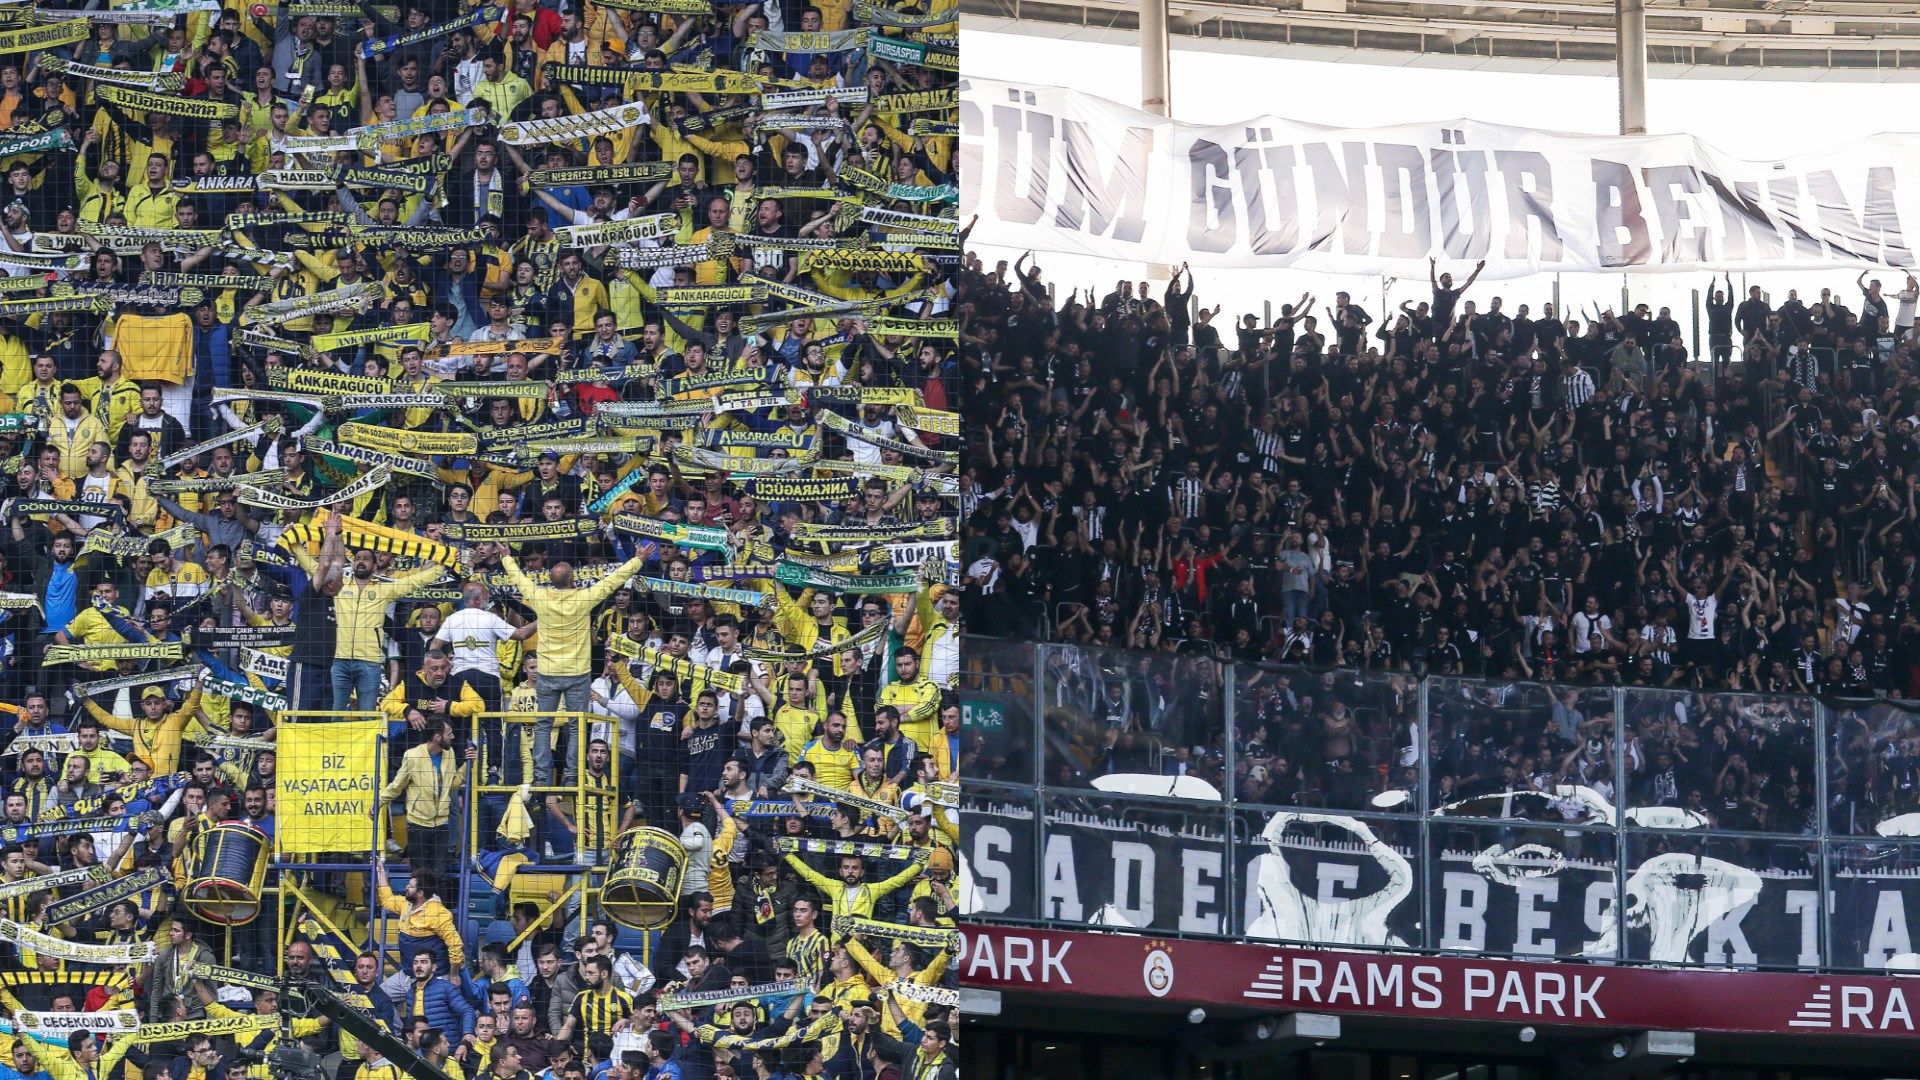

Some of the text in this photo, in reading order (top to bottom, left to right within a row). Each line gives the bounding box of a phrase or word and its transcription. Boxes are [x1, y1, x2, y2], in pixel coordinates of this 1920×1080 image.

[876, 40, 922, 60] BURSASPOR
[196, 175, 254, 191] ANKARA
[344, 167, 427, 195] ANKARAGÜCÜ
[1188, 126, 1563, 263] GÜNDÜR
[1591, 157, 1916, 268] BENİM
[577, 223, 657, 247] ANKARAGÜCÜ
[674, 289, 745, 301] ANKARAGÜCÜ
[295, 375, 383, 394] ANKARAGÜCÜ
[343, 393, 444, 406] ANKARAGÜCÜ
[718, 430, 805, 448] ANKARAGÜCÜ
[322, 441, 424, 474] ANKARAGÜCÜ
[80, 492, 107, 504] 2017
[466, 519, 576, 538] FORZA ANKARAGÜCÜ
[322, 752, 346, 769] BİZ
[283, 773, 378, 796] YAŞATACAĞI
[304, 799, 364, 816] ARMAYI
[213, 968, 249, 981] FORZA
[676, 990, 702, 1002] BAŞKA
[1293, 957, 1606, 1020] RAMS PARK
[43, 1016, 115, 1029] GECEKONDU
